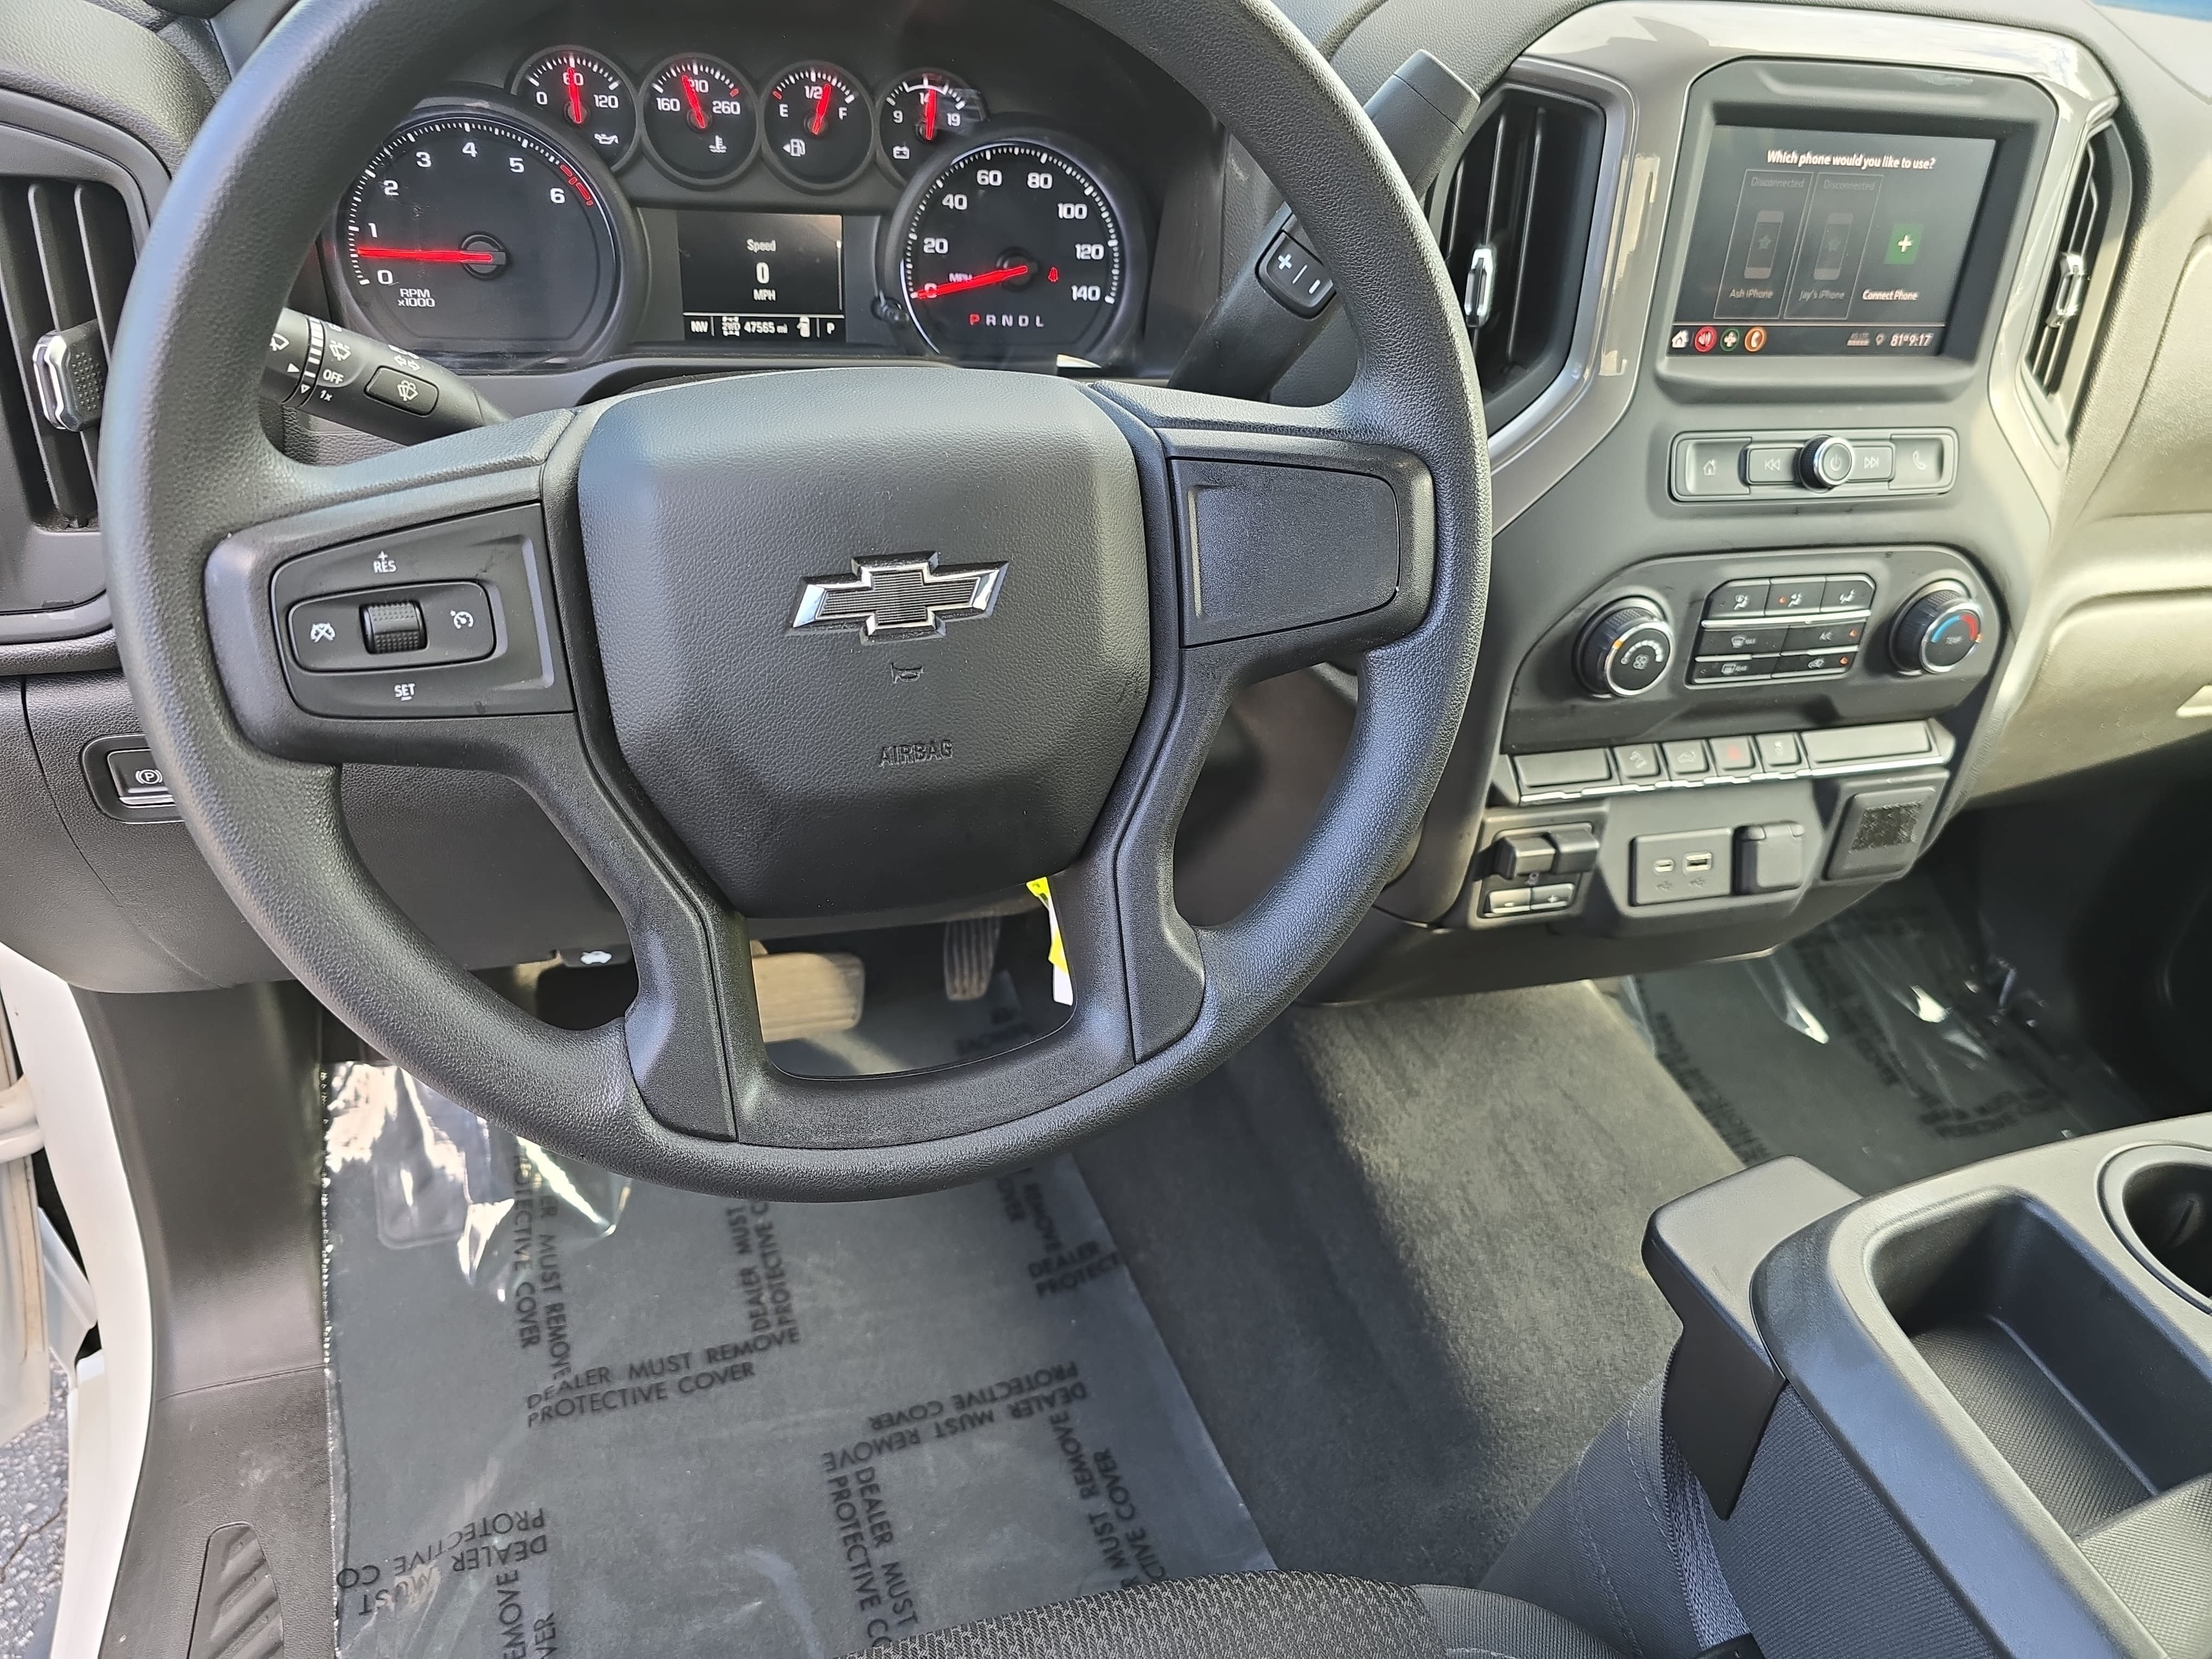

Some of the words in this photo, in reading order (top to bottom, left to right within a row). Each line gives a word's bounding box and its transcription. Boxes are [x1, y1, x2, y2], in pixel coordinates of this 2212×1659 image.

[537, 92, 548, 105] 0
[594, 94, 619, 108] 120
[656, 98, 680, 112] 160
[712, 101, 741, 114] 260
[780, 105, 788, 117] E
[839, 107, 847, 120] F
[893, 111, 903, 124] 9
[947, 113, 961, 126] 19
[462, 143, 478, 157] 4
[416, 152, 432, 168] 3
[510, 157, 524, 173] 5
[1767, 150, 1797, 163] Which
[1798, 152, 1831, 168] phone
[1832, 154, 1863, 166] would
[1861, 158, 1881, 170] you
[1882, 156, 1900, 168] like
[1901, 158, 1911, 168] to
[1913, 158, 1936, 169] use?
[977, 170, 1002, 186] 60
[1027, 173, 1052, 189] 80
[384, 181, 399, 196] 2
[550, 188, 565, 203] 6
[942, 195, 967, 210] 40
[1058, 203, 1088, 219] 100
[369, 223, 378, 237] 1
[747, 239, 776, 253] Speed
[924, 239, 948, 254] 20
[1076, 244, 1104, 260] 120
[378, 270, 393, 284] 0
[756, 262, 769, 284] 0
[400, 288, 430, 298] RPM
[753, 289, 776, 301] MPH
[1071, 286, 1101, 301] 140
[1746, 290, 1773, 298] iPhone
[1818, 290, 1844, 299] iPhone
[1862, 290, 1894, 300] Connect
[1894, 290, 1918, 300] Phone
[398, 298, 435, 307] x1000
[691, 321, 708, 332] NW
[1909, 333, 1934, 346] 9:17
[323, 369, 344, 384] OFF
[320, 390, 333, 401] 1x
[374, 561, 397, 573] RES
[395, 683, 416, 697] SET
[879, 740, 953, 767] AIRBAG
[726, 1206, 752, 1255] MUST
[540, 1234, 562, 1294] MUST
[754, 1222, 797, 1326] PROTECTIVE
[740, 1265, 770, 1332] DEALER
[516, 1281, 541, 1349] COVER
[545, 1301, 572, 1380] REMOVE
[527, 1366, 612, 1410] DEALER
[629, 1352, 694, 1382] MUST
[705, 1326, 801, 1365] REMOVE
[951, 1360, 1079, 1410] PROTECTIVE
[527, 1381, 670, 1429] PROTECTIVE
[678, 1361, 755, 1394] COVER
[1007, 1382, 1088, 1420] DEALER
[867, 1400, 943, 1430] COVER
[934, 1409, 995, 1438] MUST
[822, 1427, 920, 1474] REMOVE
[1050, 1411, 1100, 1500] REMOVE
[1093, 1448, 1136, 1522] COVER
[394, 1507, 545, 1576] PROTECTIVE
[828, 1476, 881, 1611] PROTECTIVE
[856, 1466, 893, 1549] DEALER
[882, 1561, 918, 1626] MUST
[1088, 1512, 1129, 1571] MUST
[452, 1535, 548, 1572] DEALER
[497, 1570, 526, 1659] EMOVE
[533, 1612, 558, 1659] VER
